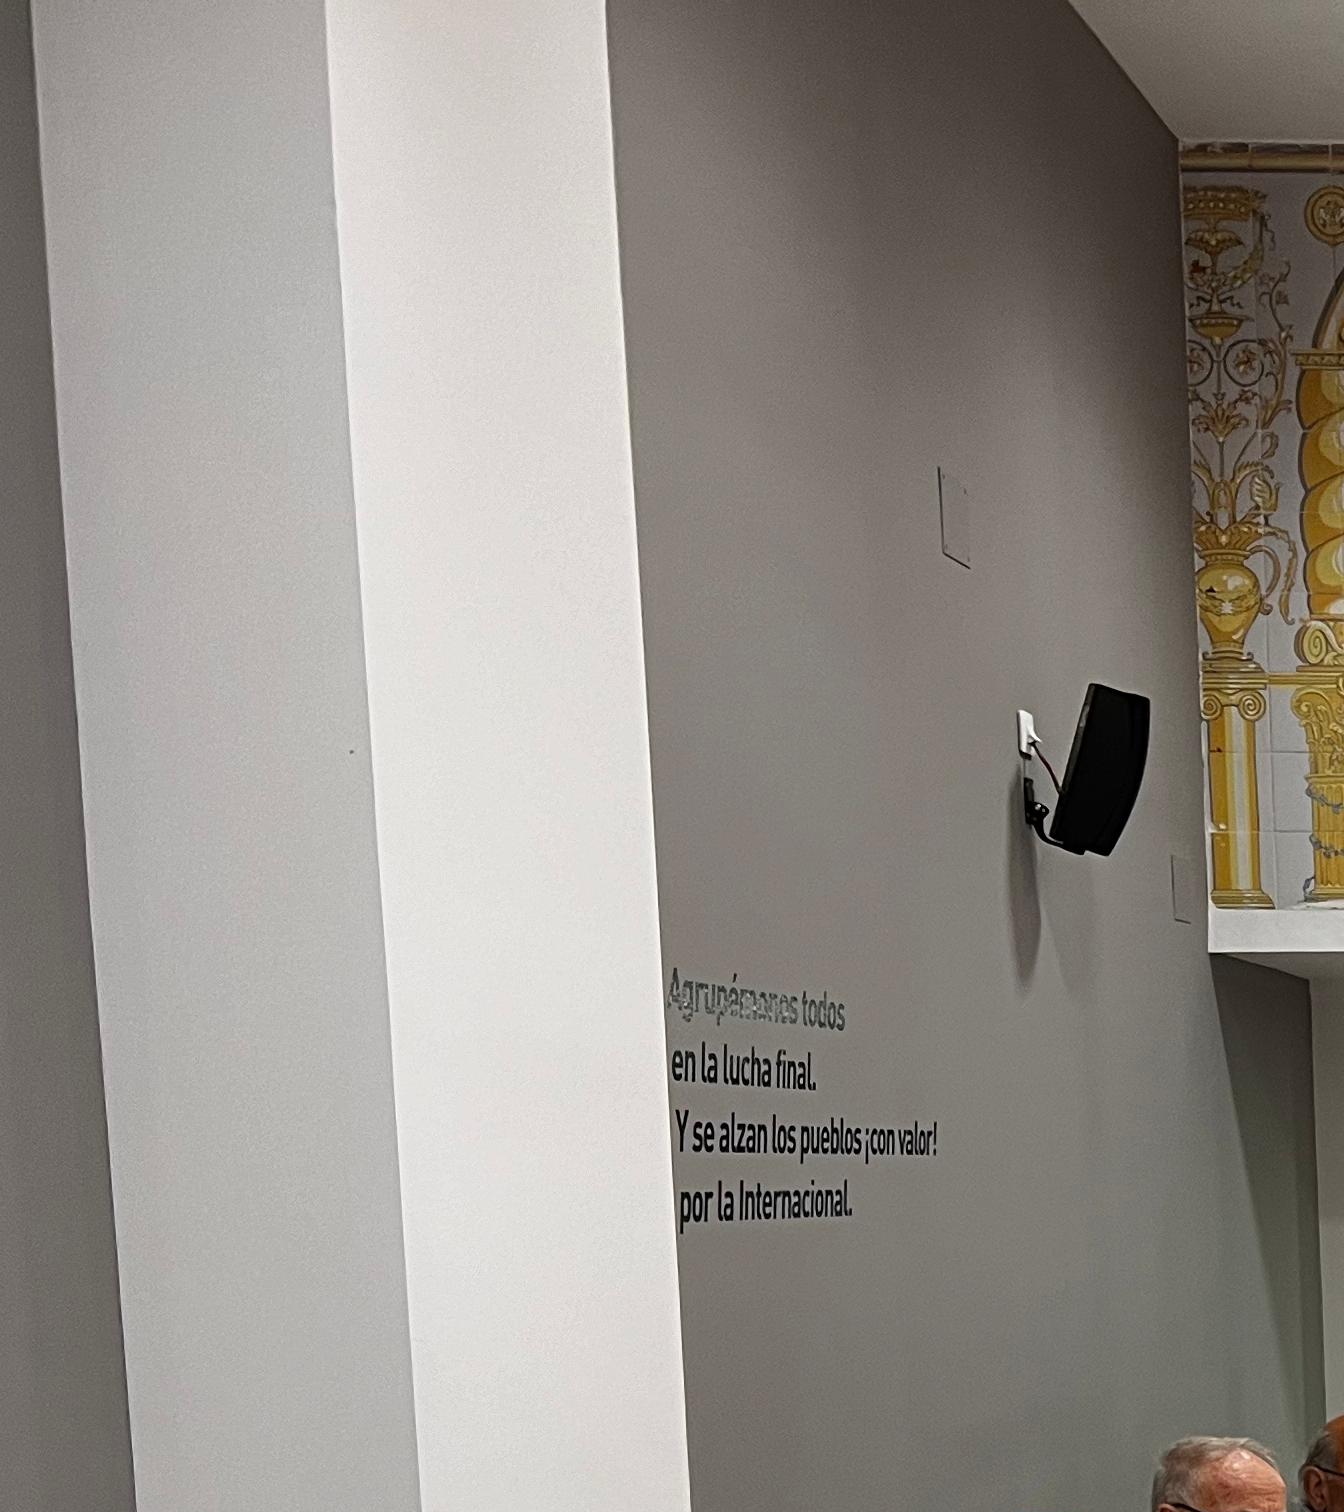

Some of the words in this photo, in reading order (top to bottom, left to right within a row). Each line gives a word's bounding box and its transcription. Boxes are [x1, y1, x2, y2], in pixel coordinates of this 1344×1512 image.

[802, 991, 846, 1031] todos
[671, 1048, 696, 1082] en
[701, 1041, 718, 1084] la
[723, 1044, 772, 1088] lucha
[776, 1048, 817, 1091] final.
[675, 1109, 689, 1153] Y
[692, 1119, 715, 1153] se
[719, 1111, 768, 1154] alzan
[772, 1113, 796, 1154] los
[800, 1116, 862, 1164] pueblos
[865, 1127, 895, 1164] ¡con
[898, 1120, 937, 1156] valor!
[680, 1189, 713, 1235] por
[717, 1180, 734, 1222] la
[739, 1178, 853, 1222] Internacional.
